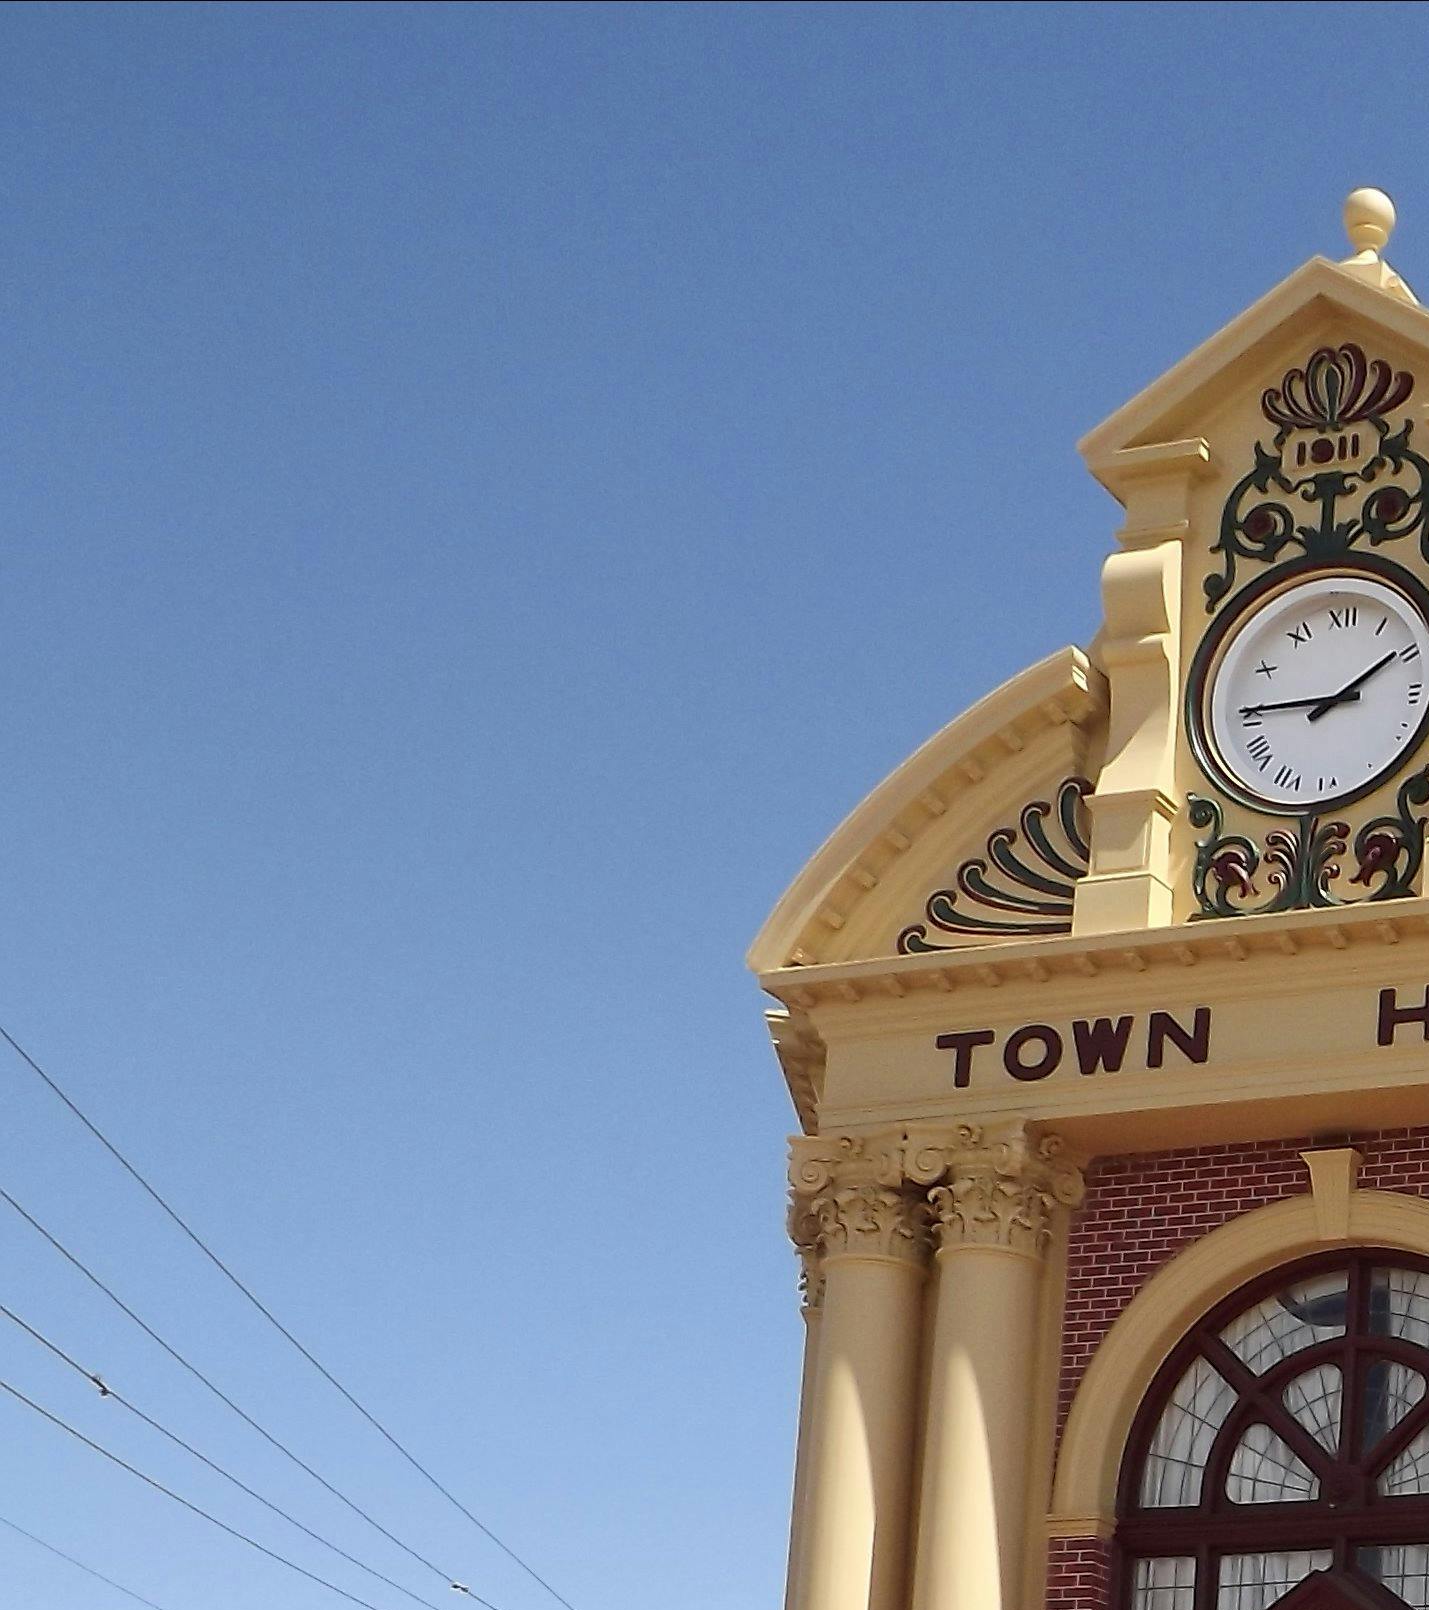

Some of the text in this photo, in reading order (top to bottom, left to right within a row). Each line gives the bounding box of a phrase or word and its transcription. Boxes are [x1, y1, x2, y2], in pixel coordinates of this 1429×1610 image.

[1296, 433, 1360, 467] 1911
[1328, 606, 1358, 630] XII
[1286, 621, 1313, 649] XI
[935, 1006, 1212, 1088] TOWN
